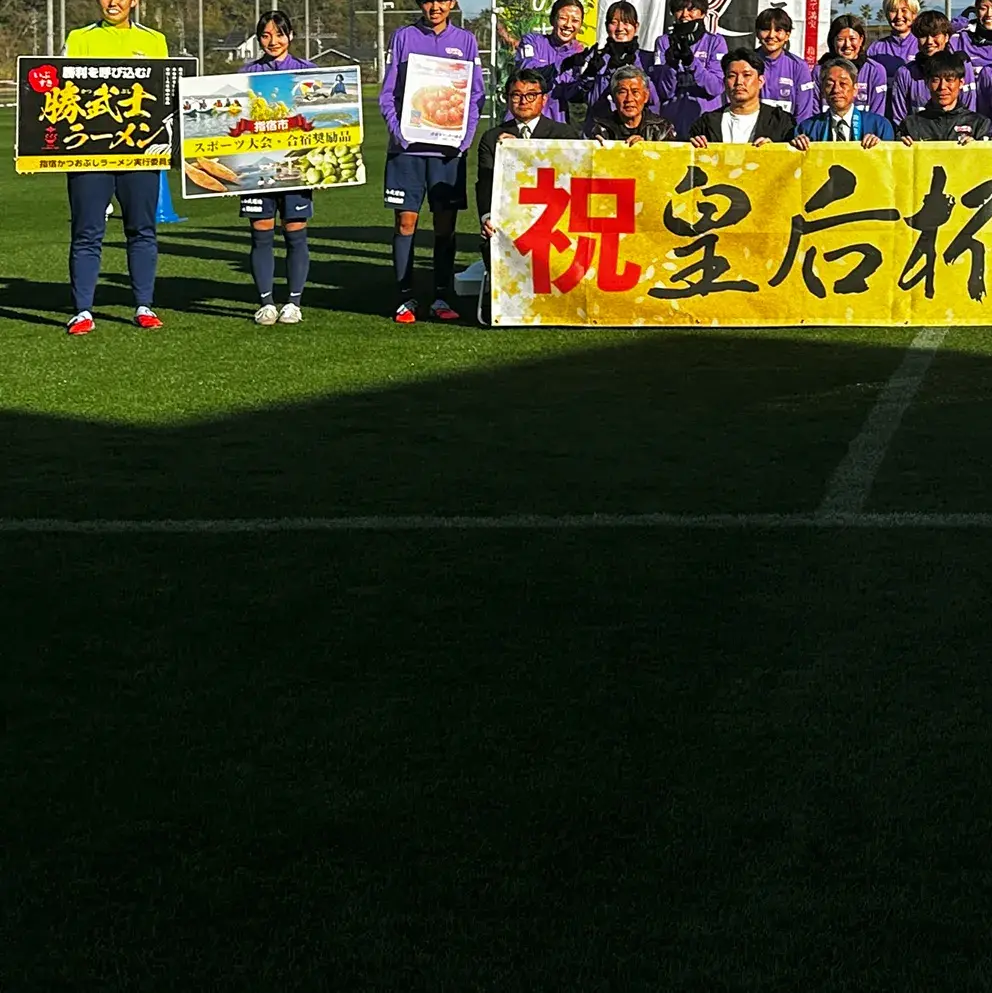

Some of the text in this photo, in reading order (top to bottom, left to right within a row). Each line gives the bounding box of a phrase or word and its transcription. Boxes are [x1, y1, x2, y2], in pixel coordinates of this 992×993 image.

[38, 80, 157, 124] 勝武士
[63, 123, 165, 151] ラーメン
[254, 119, 289, 133] 指宿市
